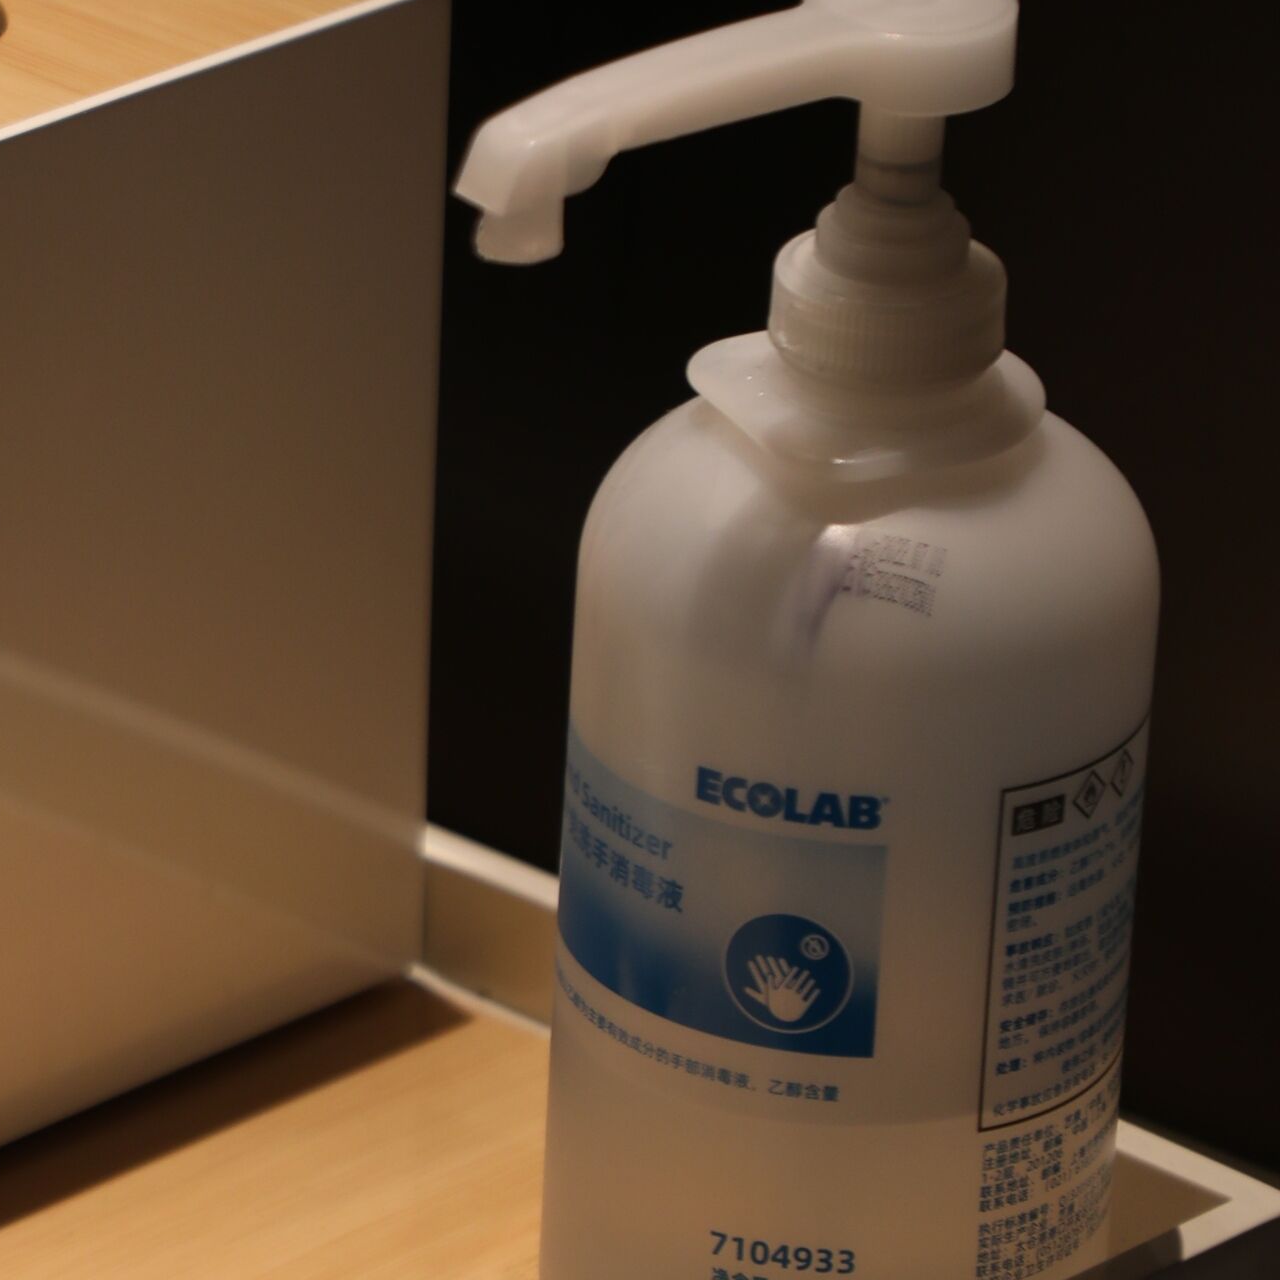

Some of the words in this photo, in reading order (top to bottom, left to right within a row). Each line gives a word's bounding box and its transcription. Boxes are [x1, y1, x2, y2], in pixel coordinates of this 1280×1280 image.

[581, 781, 673, 860] Sanitizer
[695, 765, 883, 830] ECOLAB
[710, 1230, 855, 1274] 7104933
